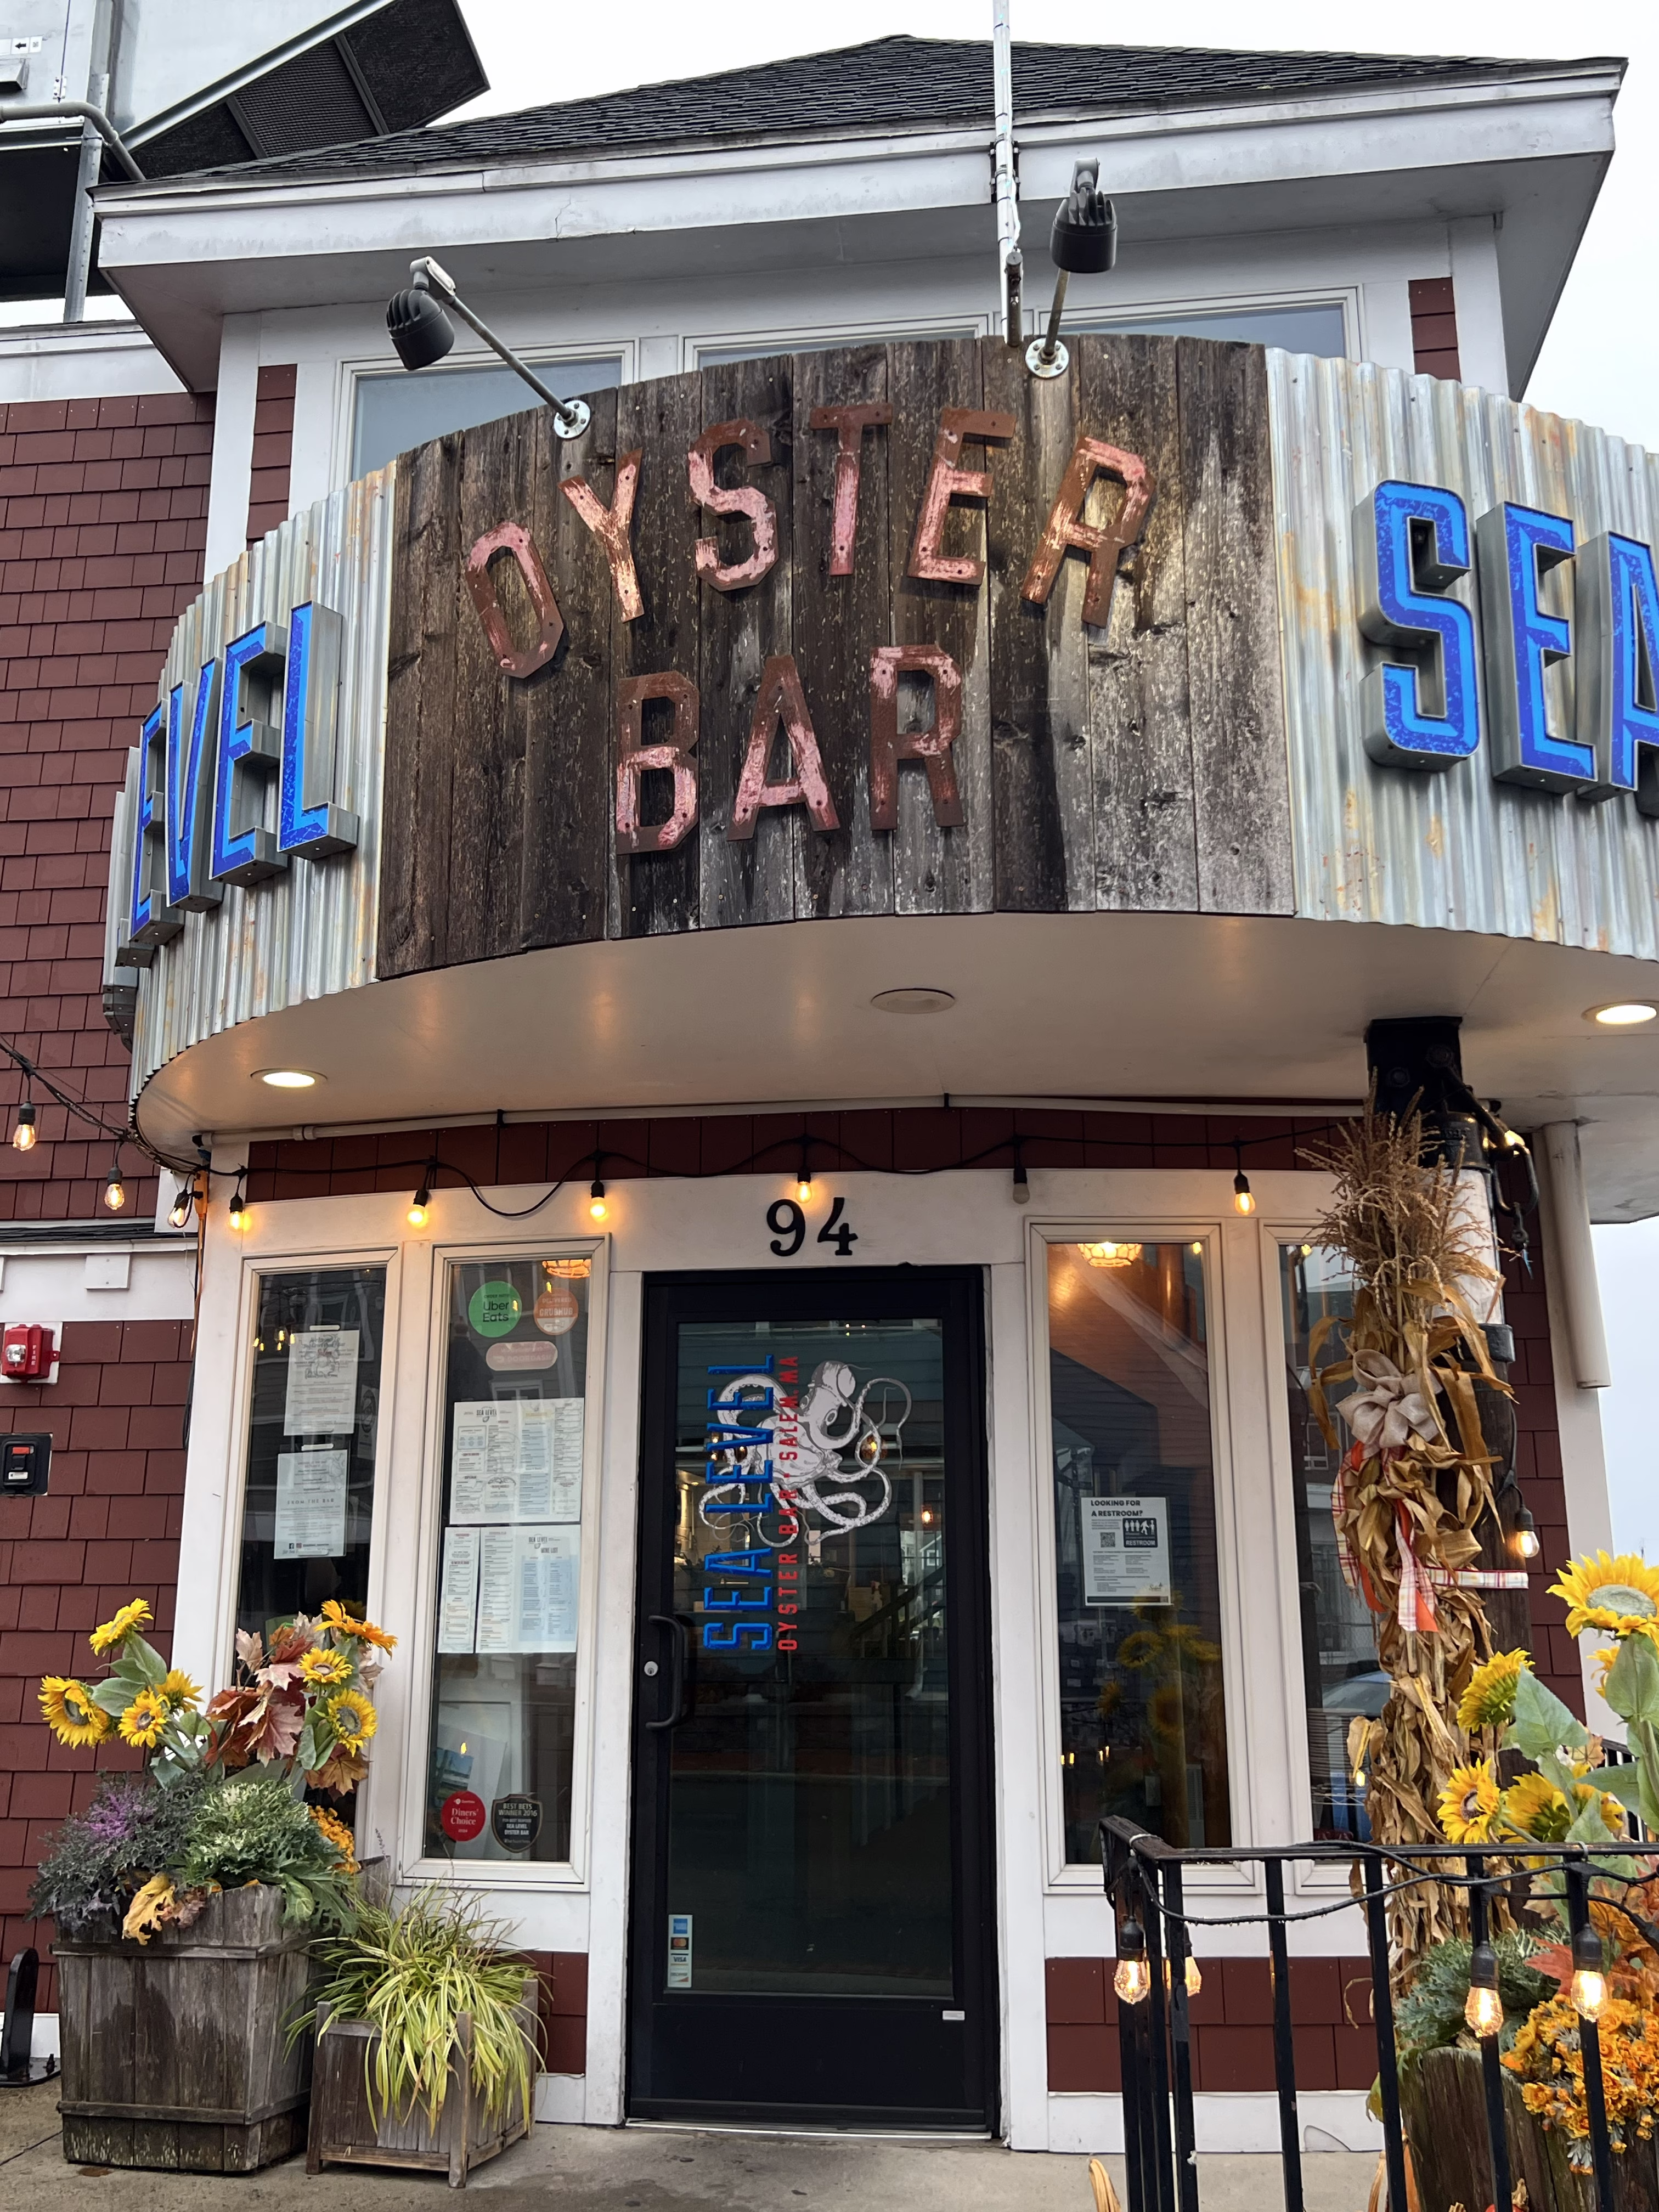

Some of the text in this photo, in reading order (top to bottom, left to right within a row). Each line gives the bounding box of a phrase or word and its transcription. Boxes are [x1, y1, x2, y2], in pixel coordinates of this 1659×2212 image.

[466, 403, 1156, 679] OYSTER
[117, 600, 354, 949] EVEL
[616, 644, 965, 855] BAR
[766, 1197, 859, 1257] 94
[483, 1301, 510, 1311] Uber
[483, 1312, 509, 1323] Eats
[539, 1307, 573, 1317] GRUBHUB
[778, 1356, 799, 1384] MA
[703, 1354, 774, 1650] SEA LEVEL
[778, 1489, 798, 1534] BAR
[777, 1553, 798, 1651] OYSTER
[450, 1816, 477, 1826] Choice
